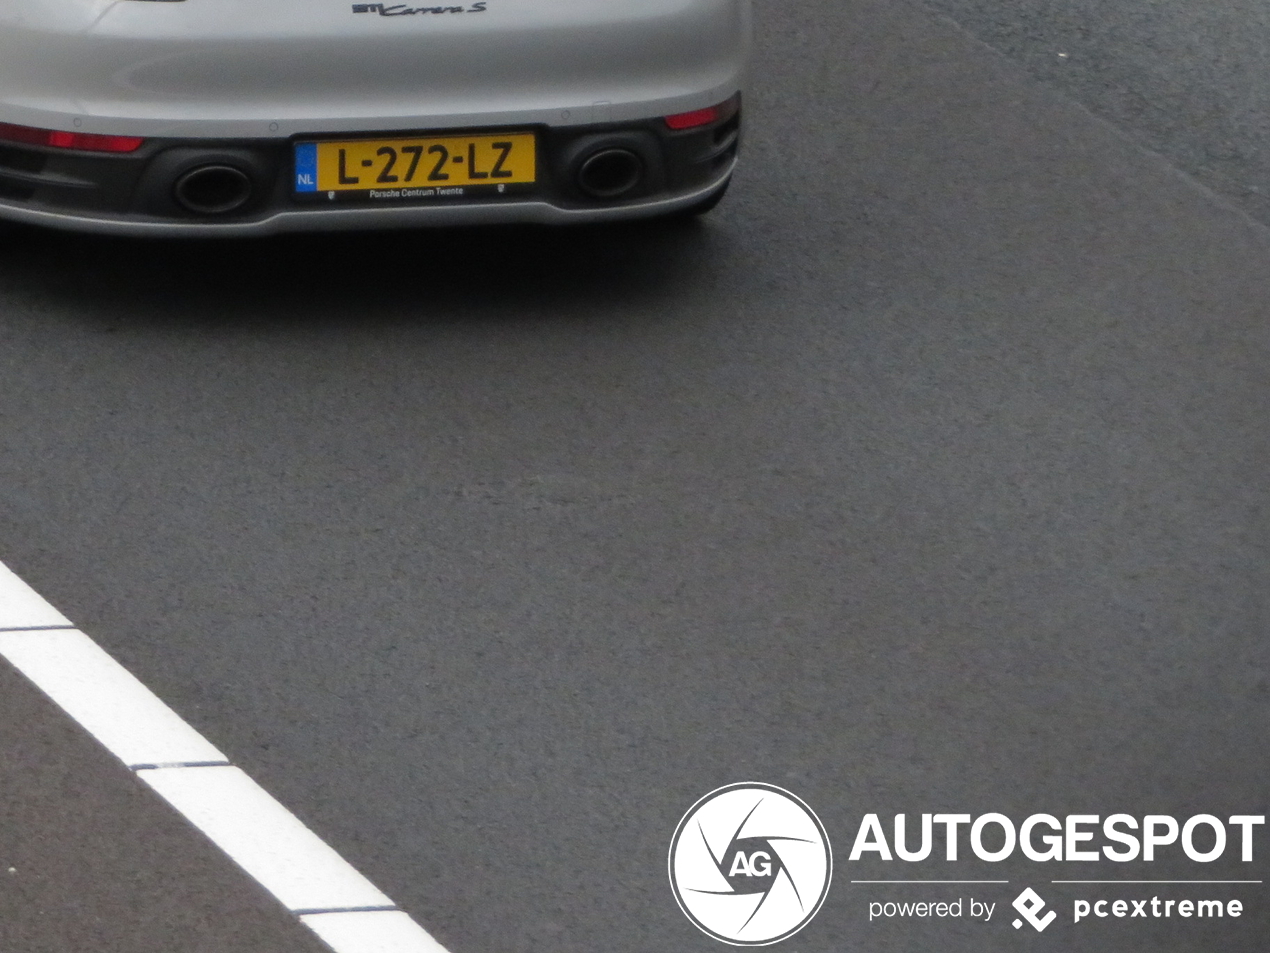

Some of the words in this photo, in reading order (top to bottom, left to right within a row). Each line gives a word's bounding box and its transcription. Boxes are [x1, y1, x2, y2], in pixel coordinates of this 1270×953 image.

[466, 1, 487, 13] S
[338, 141, 513, 185] L-272-LZ
[298, 174, 314, 185] NL
[370, 189, 400, 198] Porsche
[401, 188, 435, 197] Centrum
[436, 187, 464, 195] Twente
